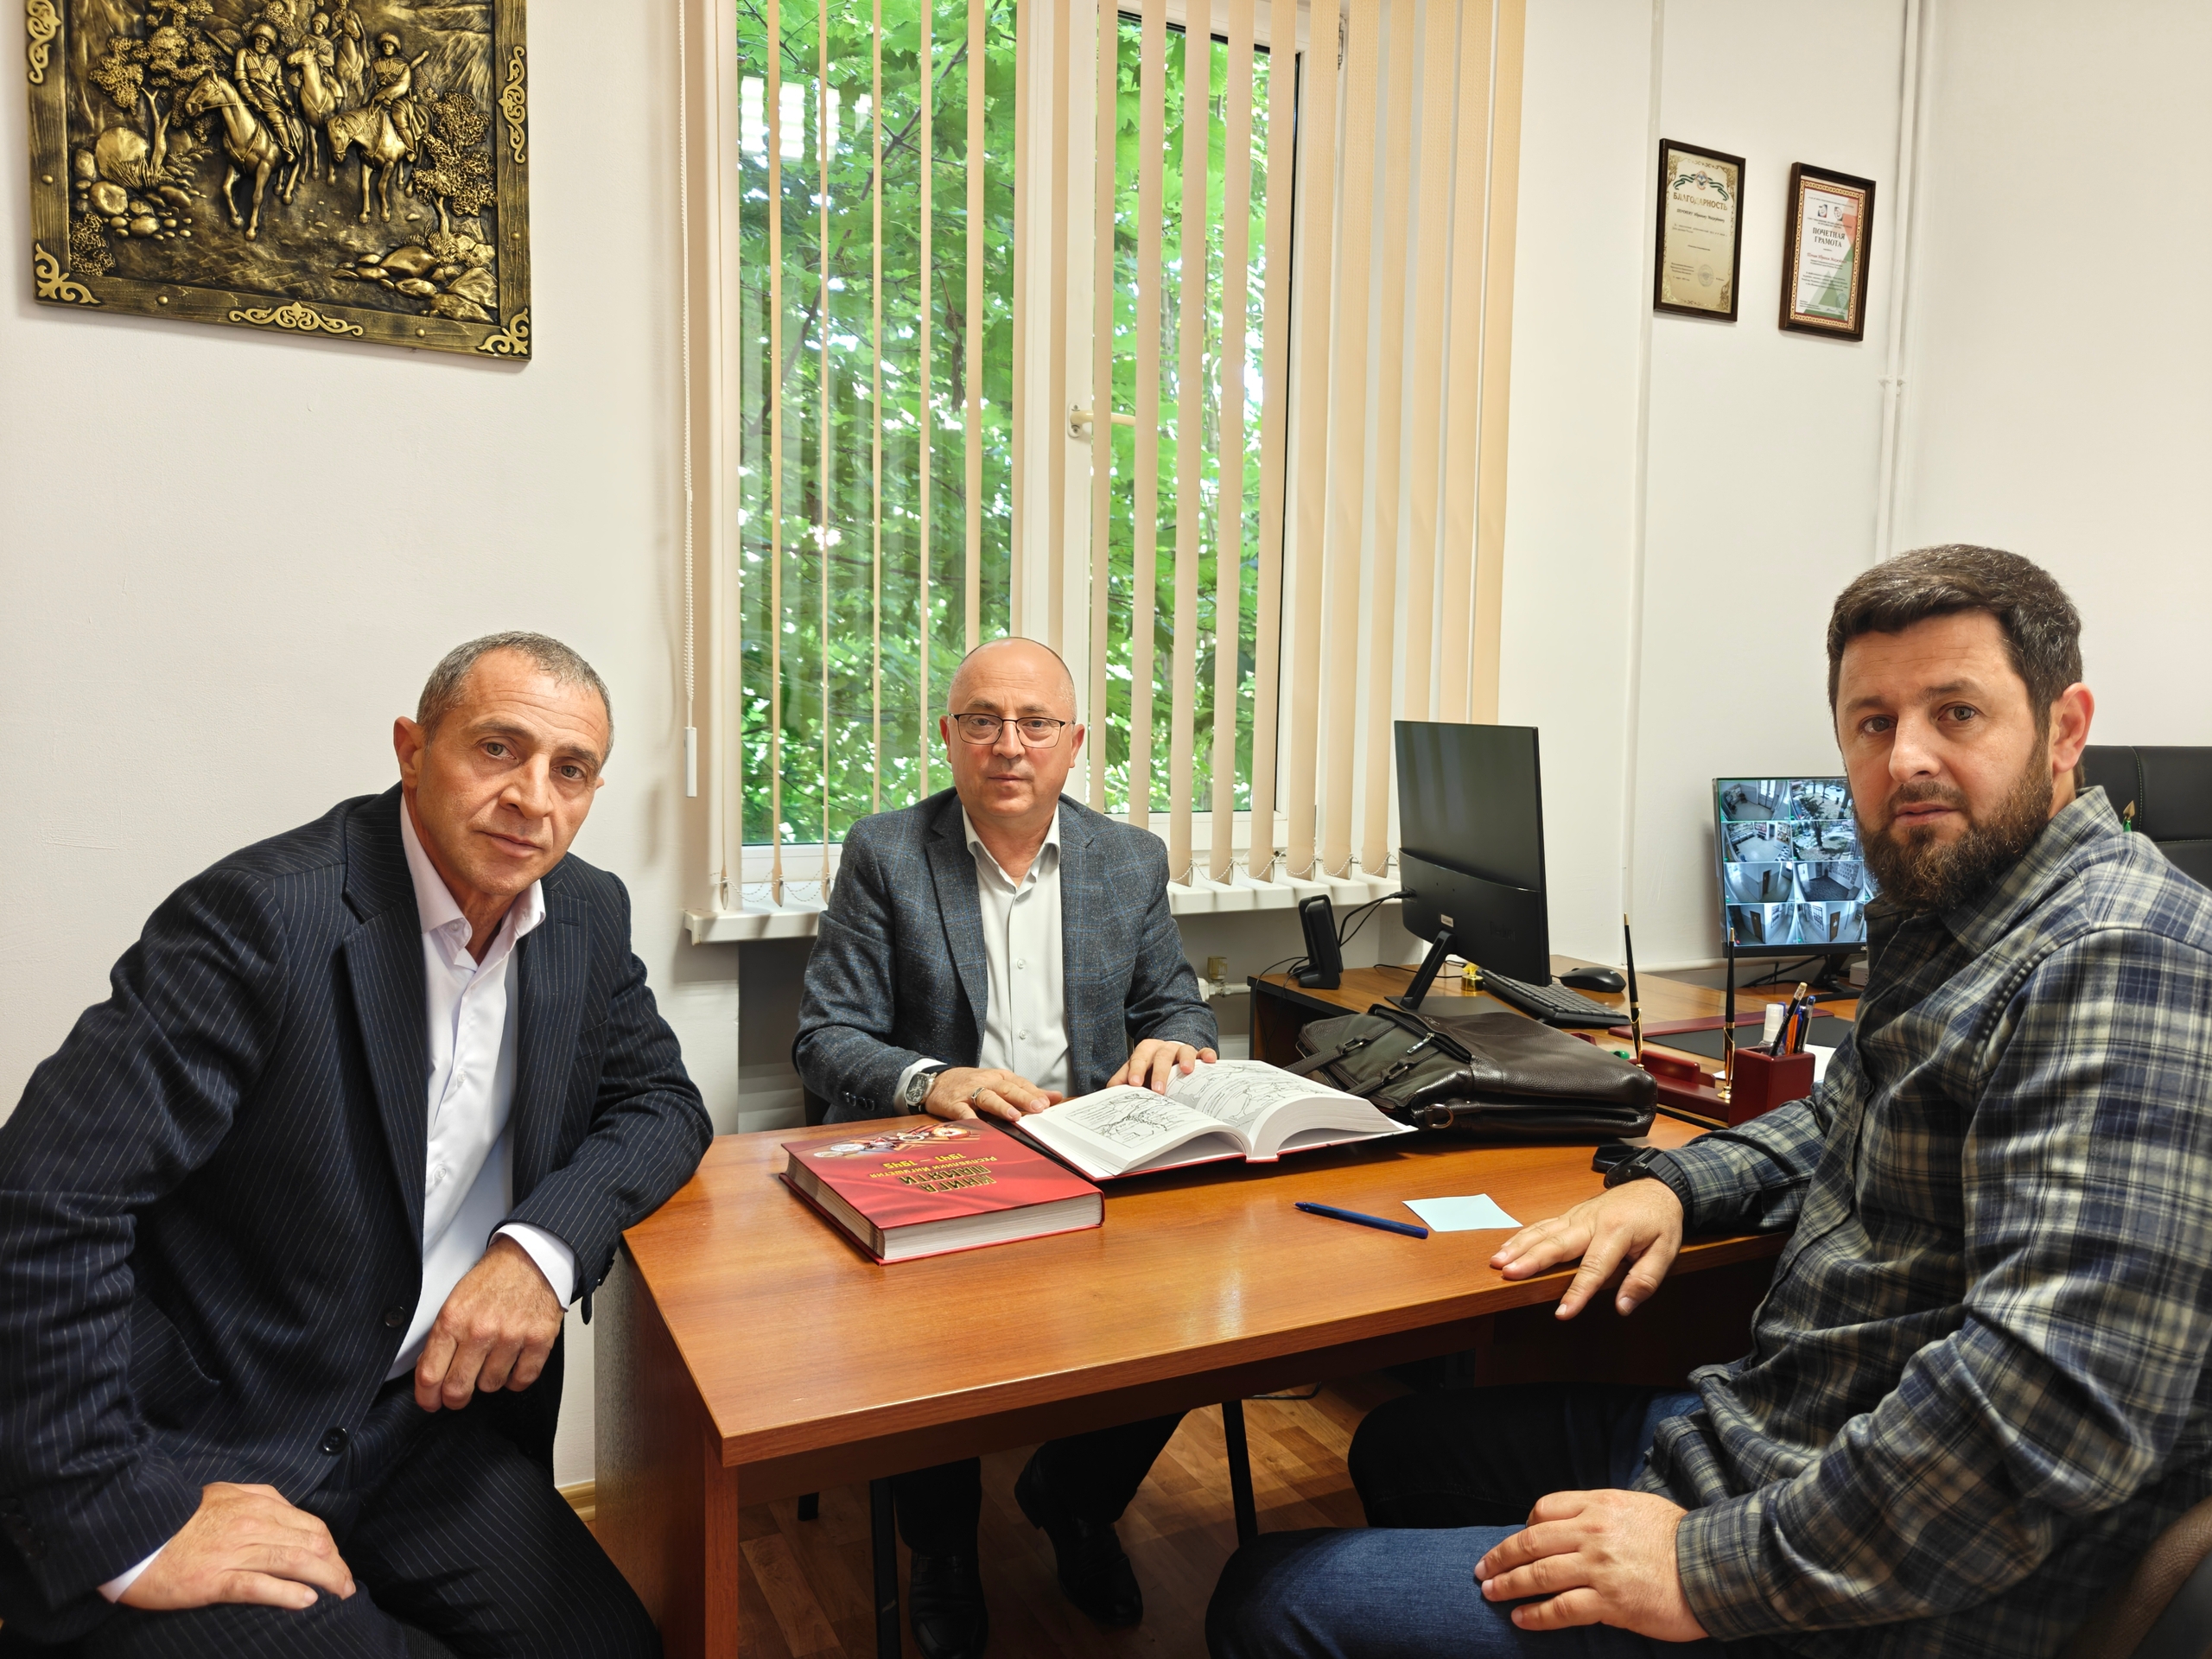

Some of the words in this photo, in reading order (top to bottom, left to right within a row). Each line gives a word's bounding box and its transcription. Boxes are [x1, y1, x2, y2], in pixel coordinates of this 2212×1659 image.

[1673, 192, 1728, 211] БЛАГОДАРНОСТЬ
[1812, 226, 1846, 240] ПОЧЕТНАЯ
[1814, 235, 1842, 248] ГРАМОТА
[882, 1160, 918, 1169] 1945
[934, 1153, 966, 1162] 1941
[899, 1165, 991, 1185] ПАМЯТИ
[918, 1175, 996, 1193] КНИГА
